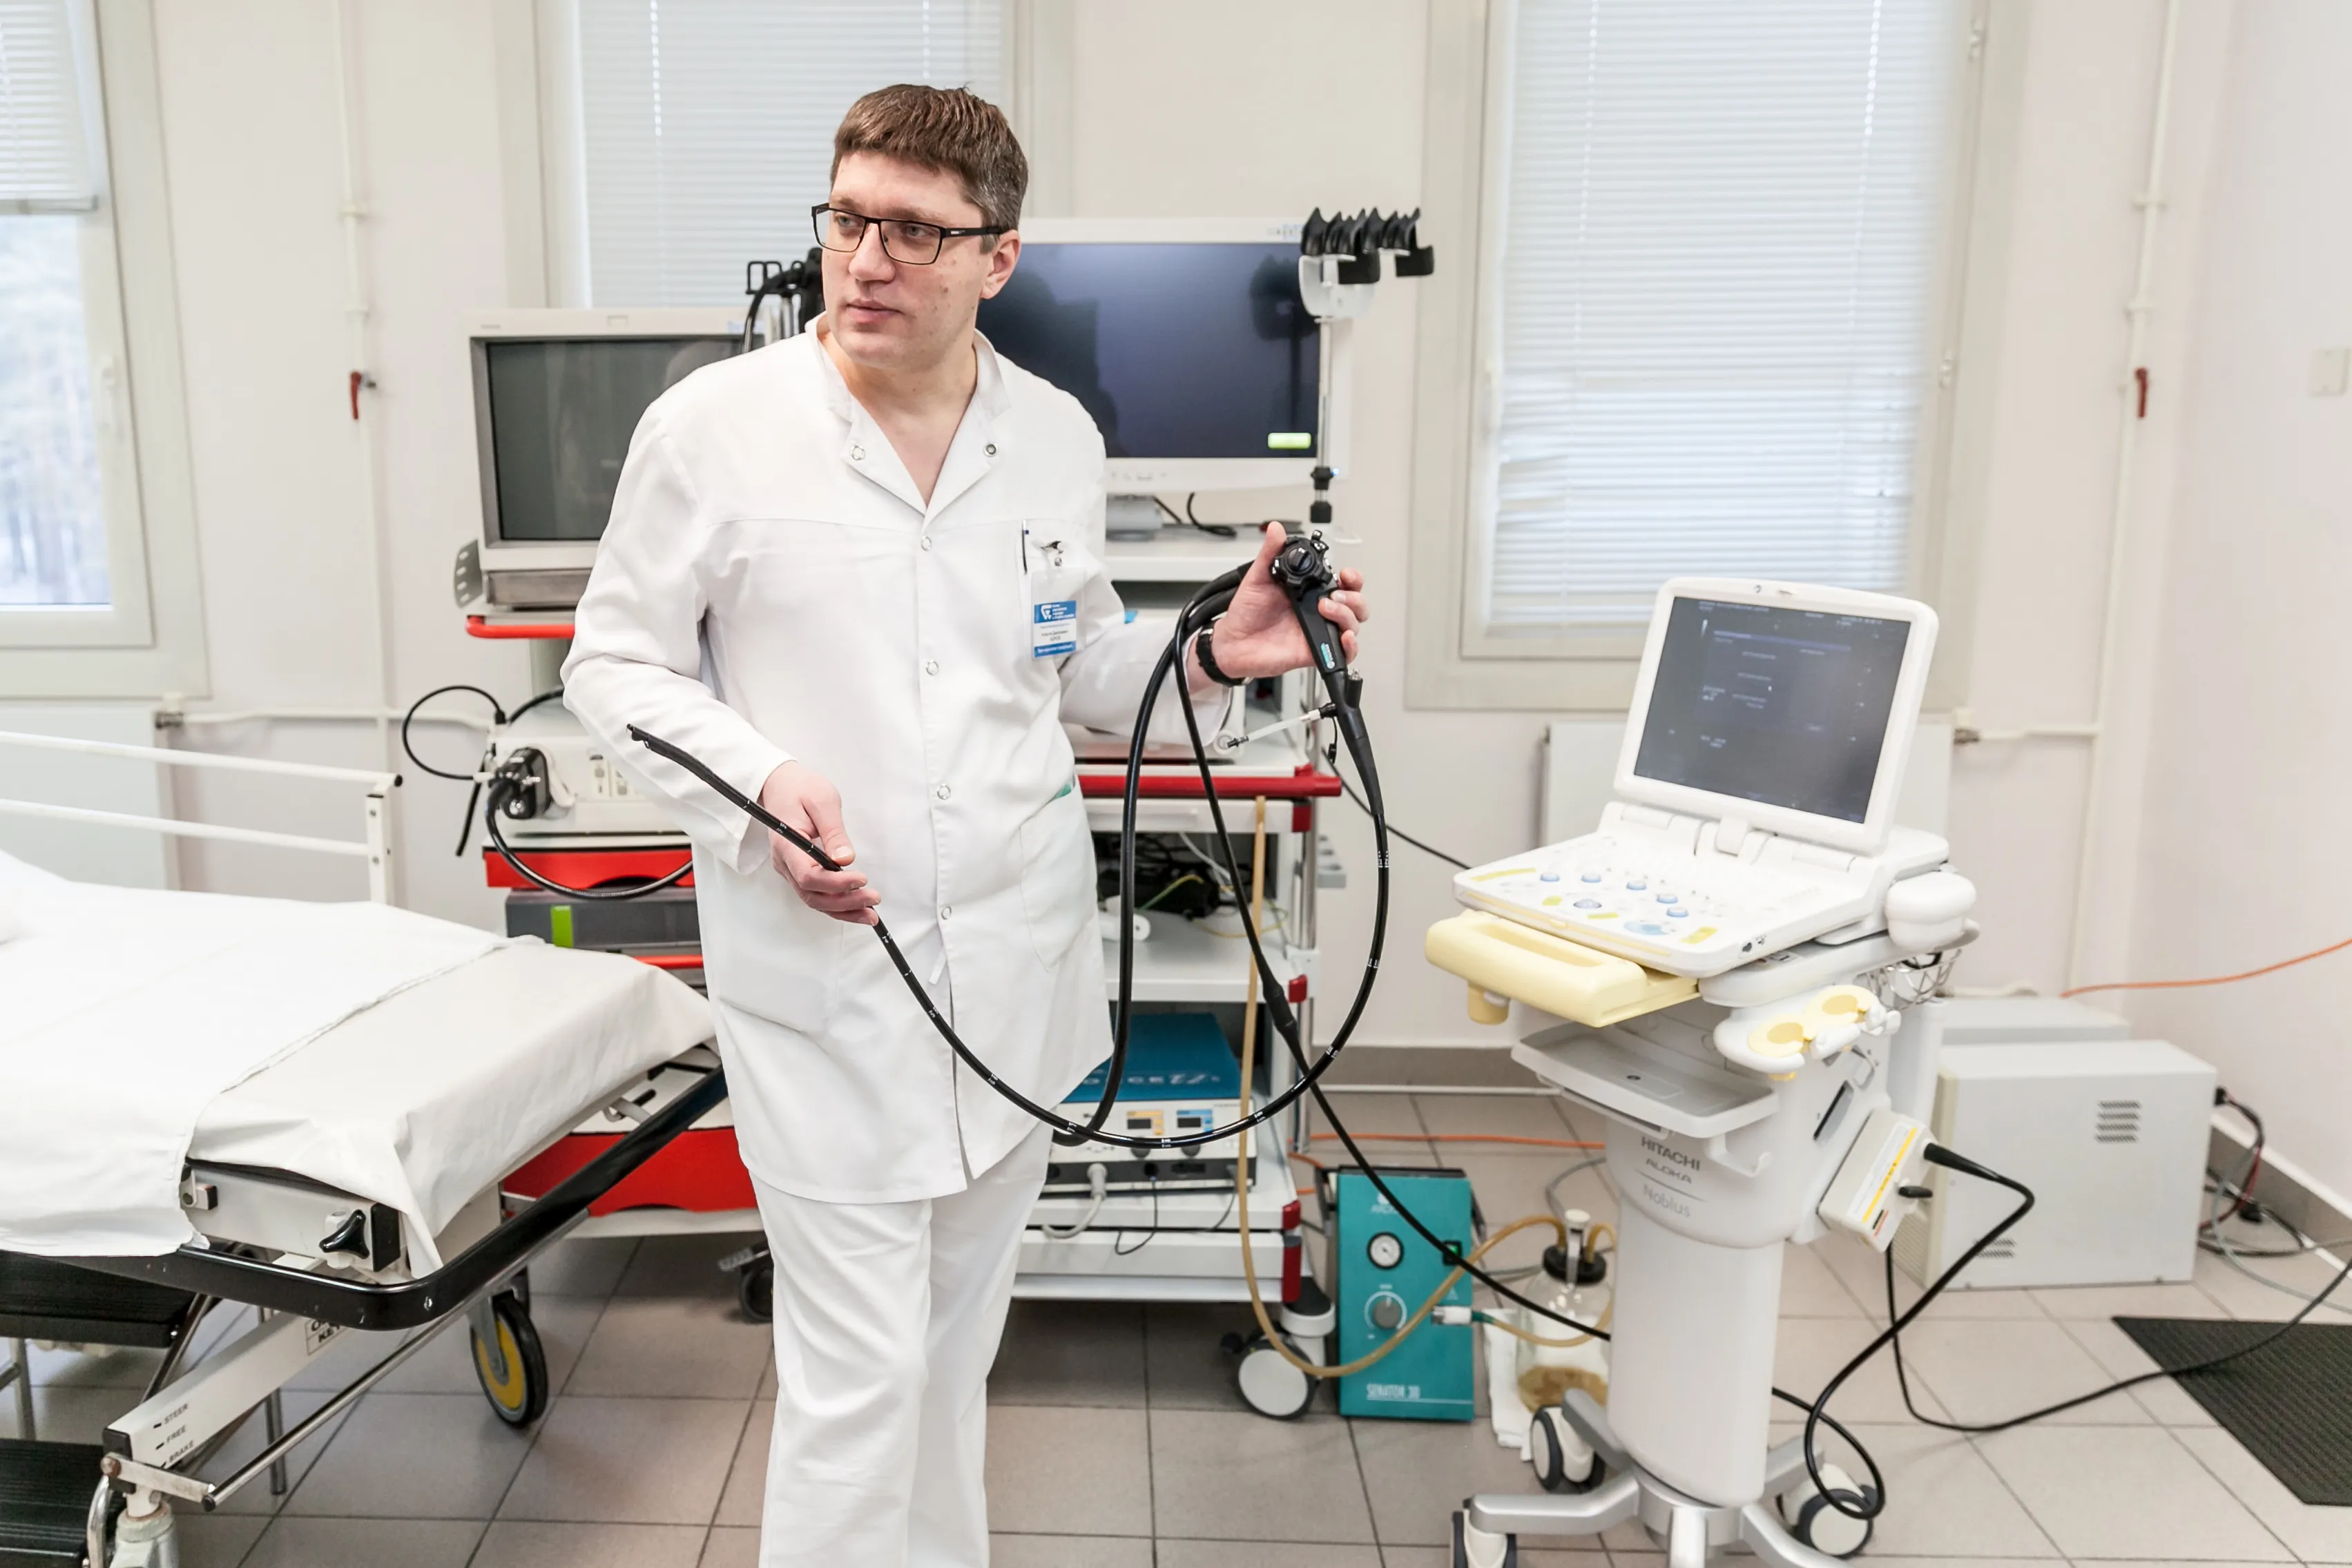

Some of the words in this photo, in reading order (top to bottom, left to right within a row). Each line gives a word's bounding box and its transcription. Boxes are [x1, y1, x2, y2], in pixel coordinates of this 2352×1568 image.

[1641, 1135, 1700, 1171] HITACHI
[1646, 1158, 1692, 1184] ALOKA
[318, 1325, 340, 1343] KE
[164, 1403, 189, 1424] STEER
[166, 1424, 186, 1444] FREE
